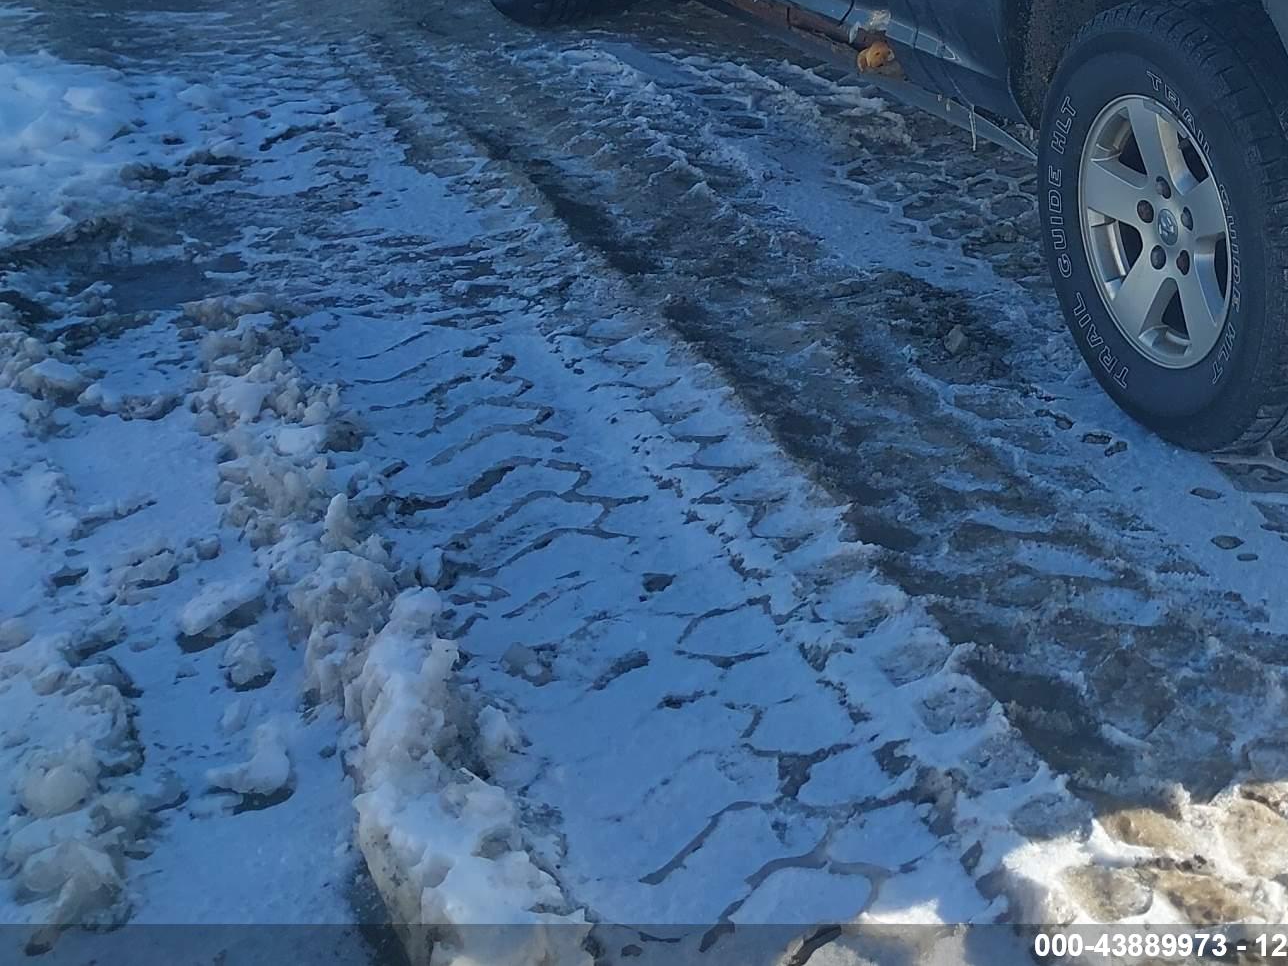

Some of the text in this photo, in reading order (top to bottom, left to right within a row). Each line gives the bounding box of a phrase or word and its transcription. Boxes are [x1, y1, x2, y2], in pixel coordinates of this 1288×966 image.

[1048, 95, 1130, 389] TRAIL GUIDE HLT
[1218, 184, 1243, 313] GUIDE
